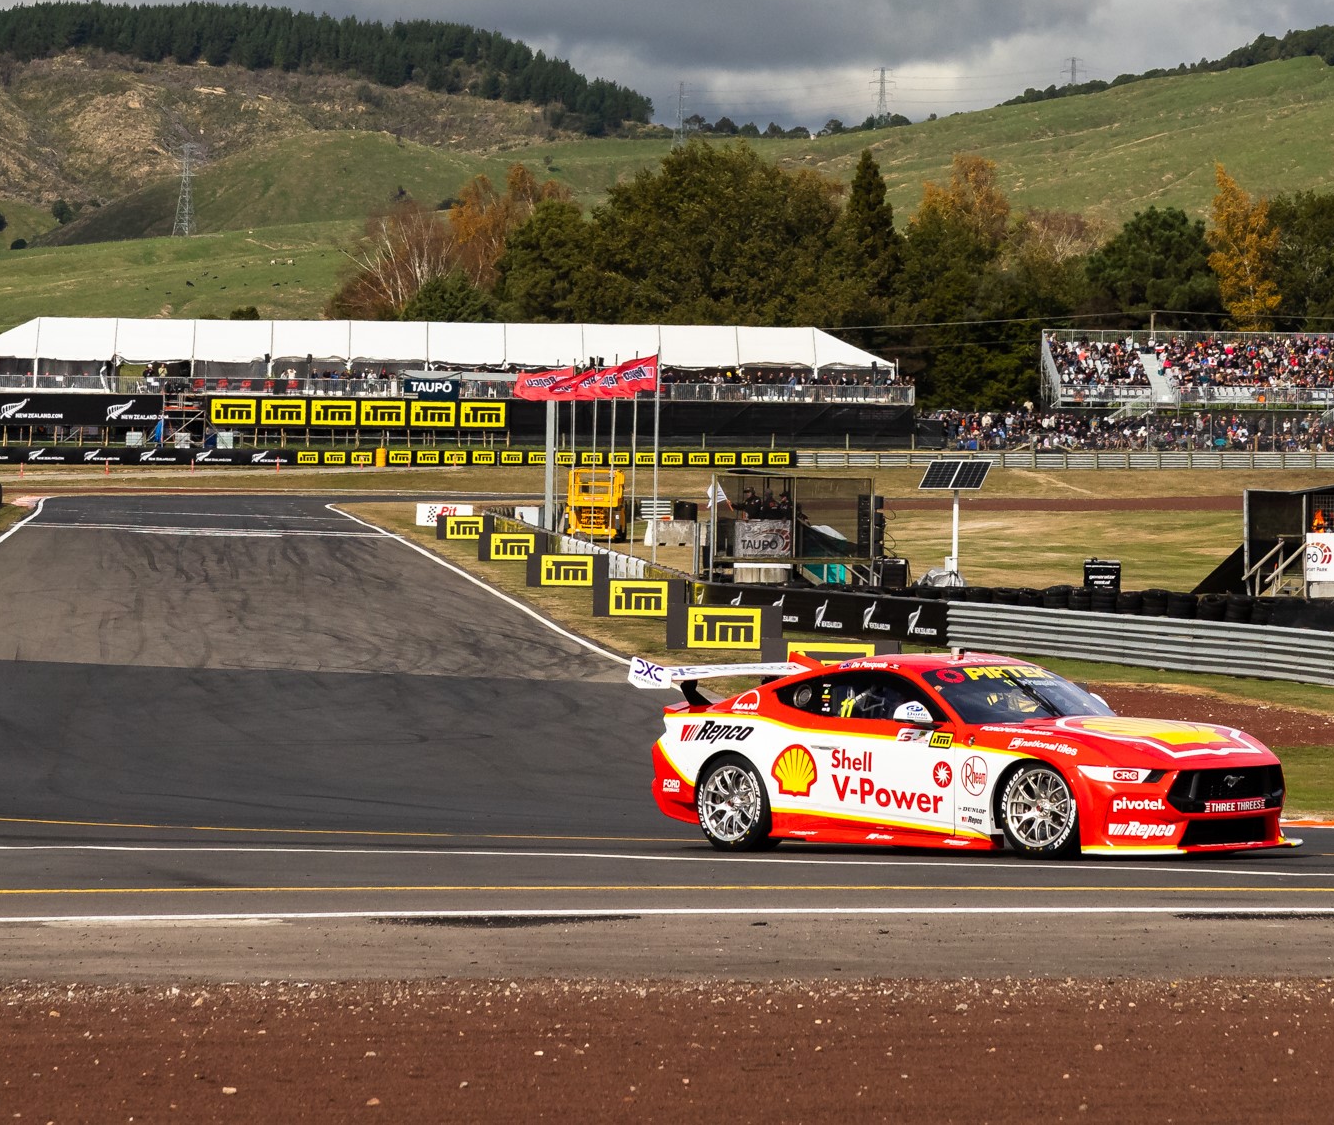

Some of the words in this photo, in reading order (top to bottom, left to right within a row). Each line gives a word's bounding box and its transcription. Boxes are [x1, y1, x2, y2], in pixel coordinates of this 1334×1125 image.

[634, 659, 664, 682] DXC
[862, 661, 888, 670] Pasquale
[963, 665, 1055, 681] PIRTEK
[840, 697, 856, 718] 11
[695, 720, 755, 744] Repco
[1021, 740, 1058, 752] national
[1058, 744, 1078, 756] tiles
[831, 749, 873, 772] Shell
[663, 779, 680, 788] FORD
[1114, 771, 1137, 781] CRC
[831, 774, 944, 814] V-Power
[1001, 768, 1024, 811] DUNLOP
[962, 806, 987, 814] DUNLOP
[1113, 797, 1166, 813] pivotel.
[1211, 802, 1236, 812] THREE
[1236, 800, 1262, 811] THREES
[967, 815, 983, 825] Repco
[1124, 821, 1176, 839] Repco
